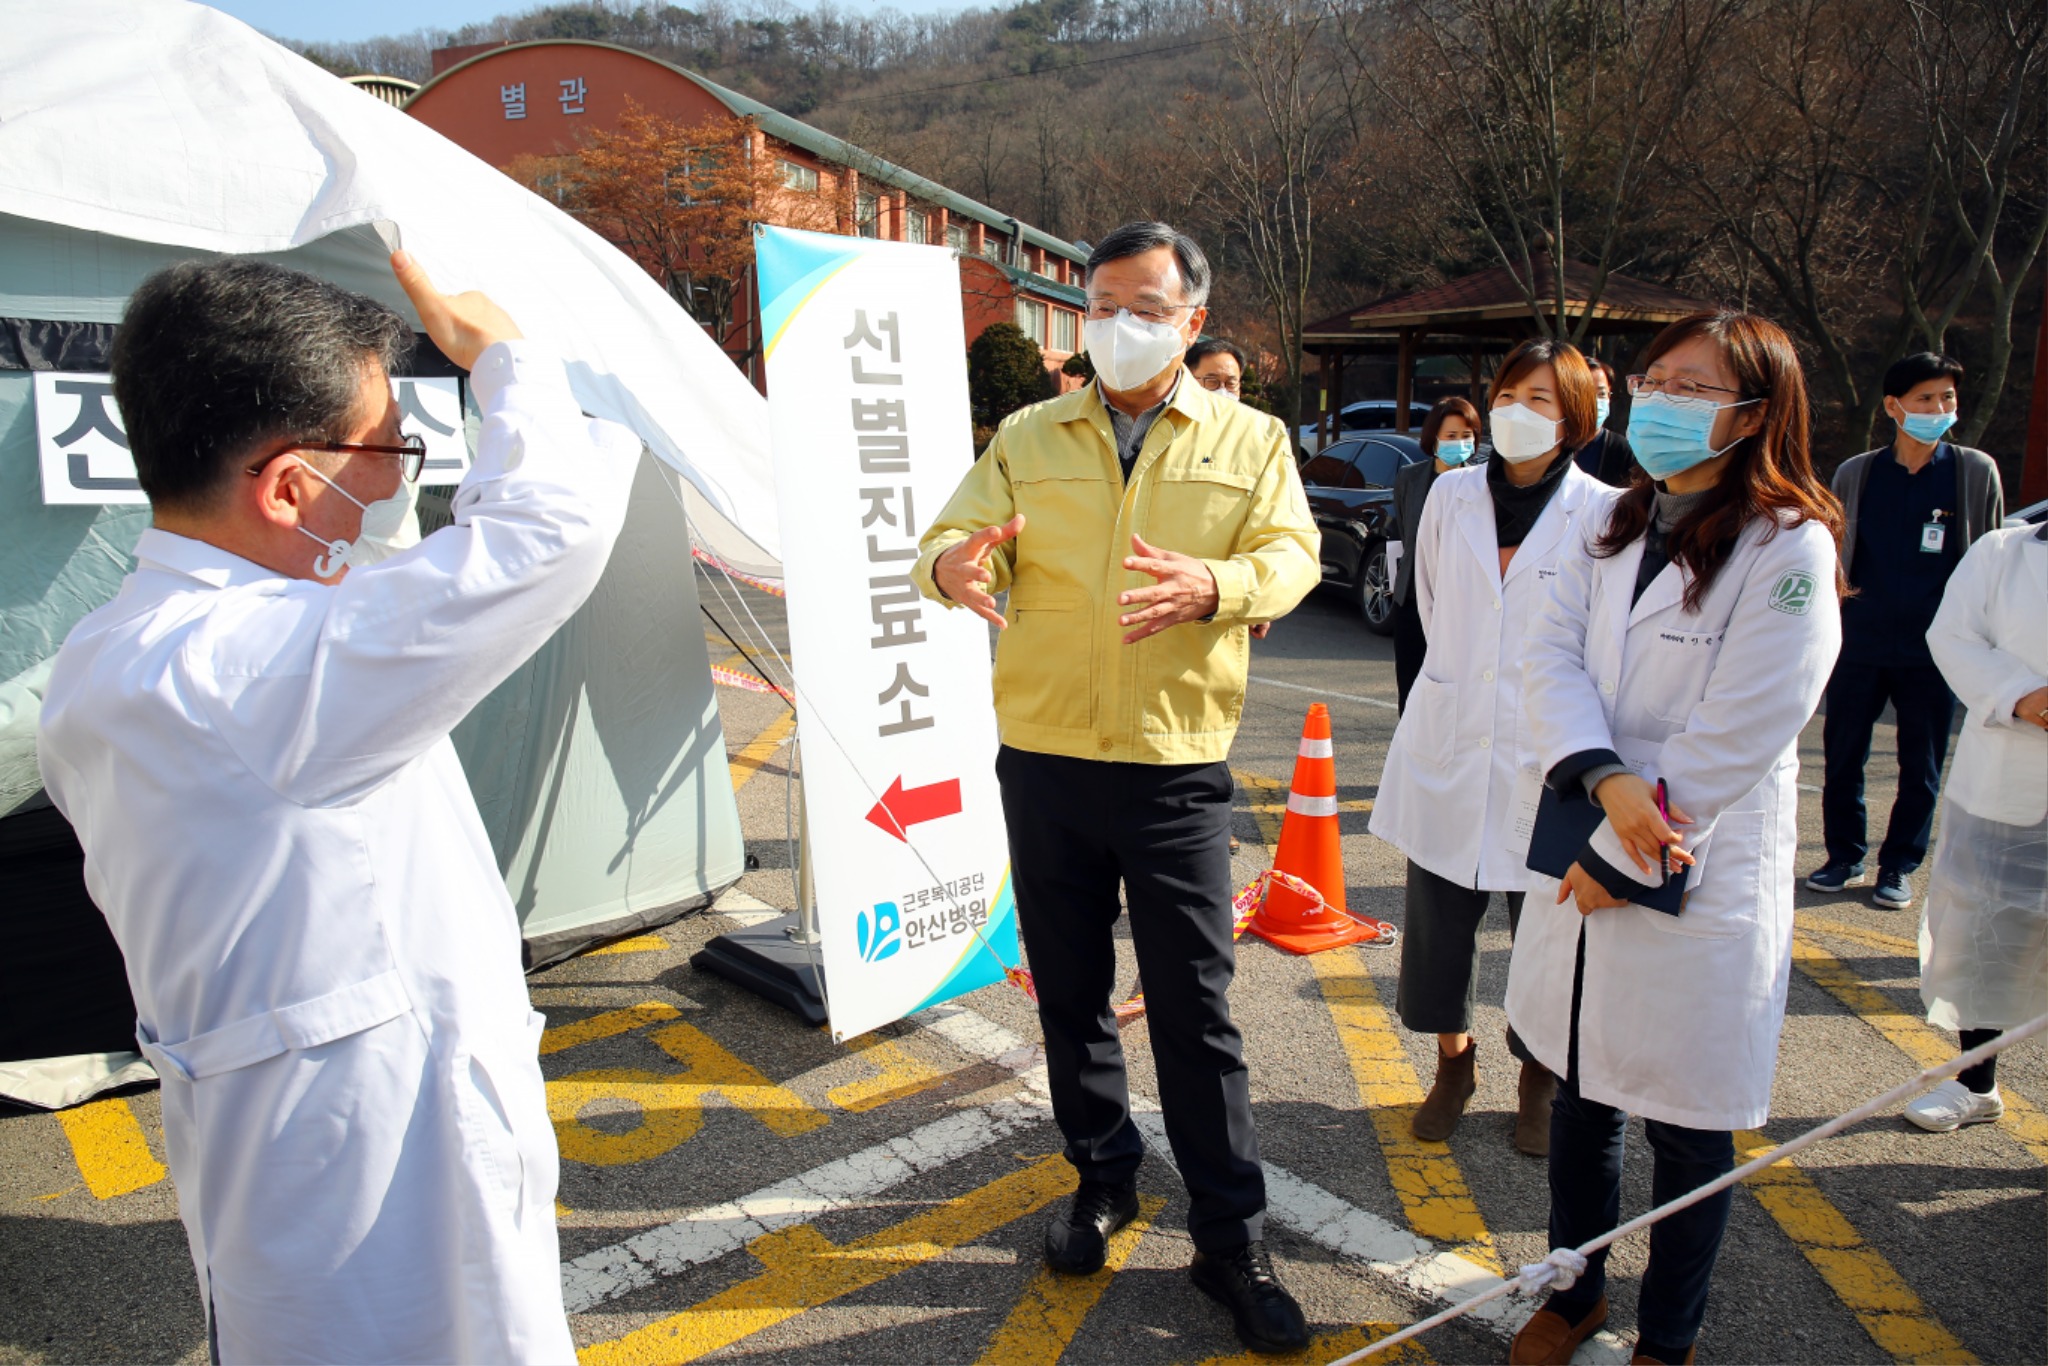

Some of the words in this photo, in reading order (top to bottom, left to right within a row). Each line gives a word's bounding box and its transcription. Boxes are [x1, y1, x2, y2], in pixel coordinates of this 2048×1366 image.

[843, 308, 935, 738] 선별진료소
[903, 872, 985, 914] 근로복지공단
[905, 898, 988, 949] 안산병원
